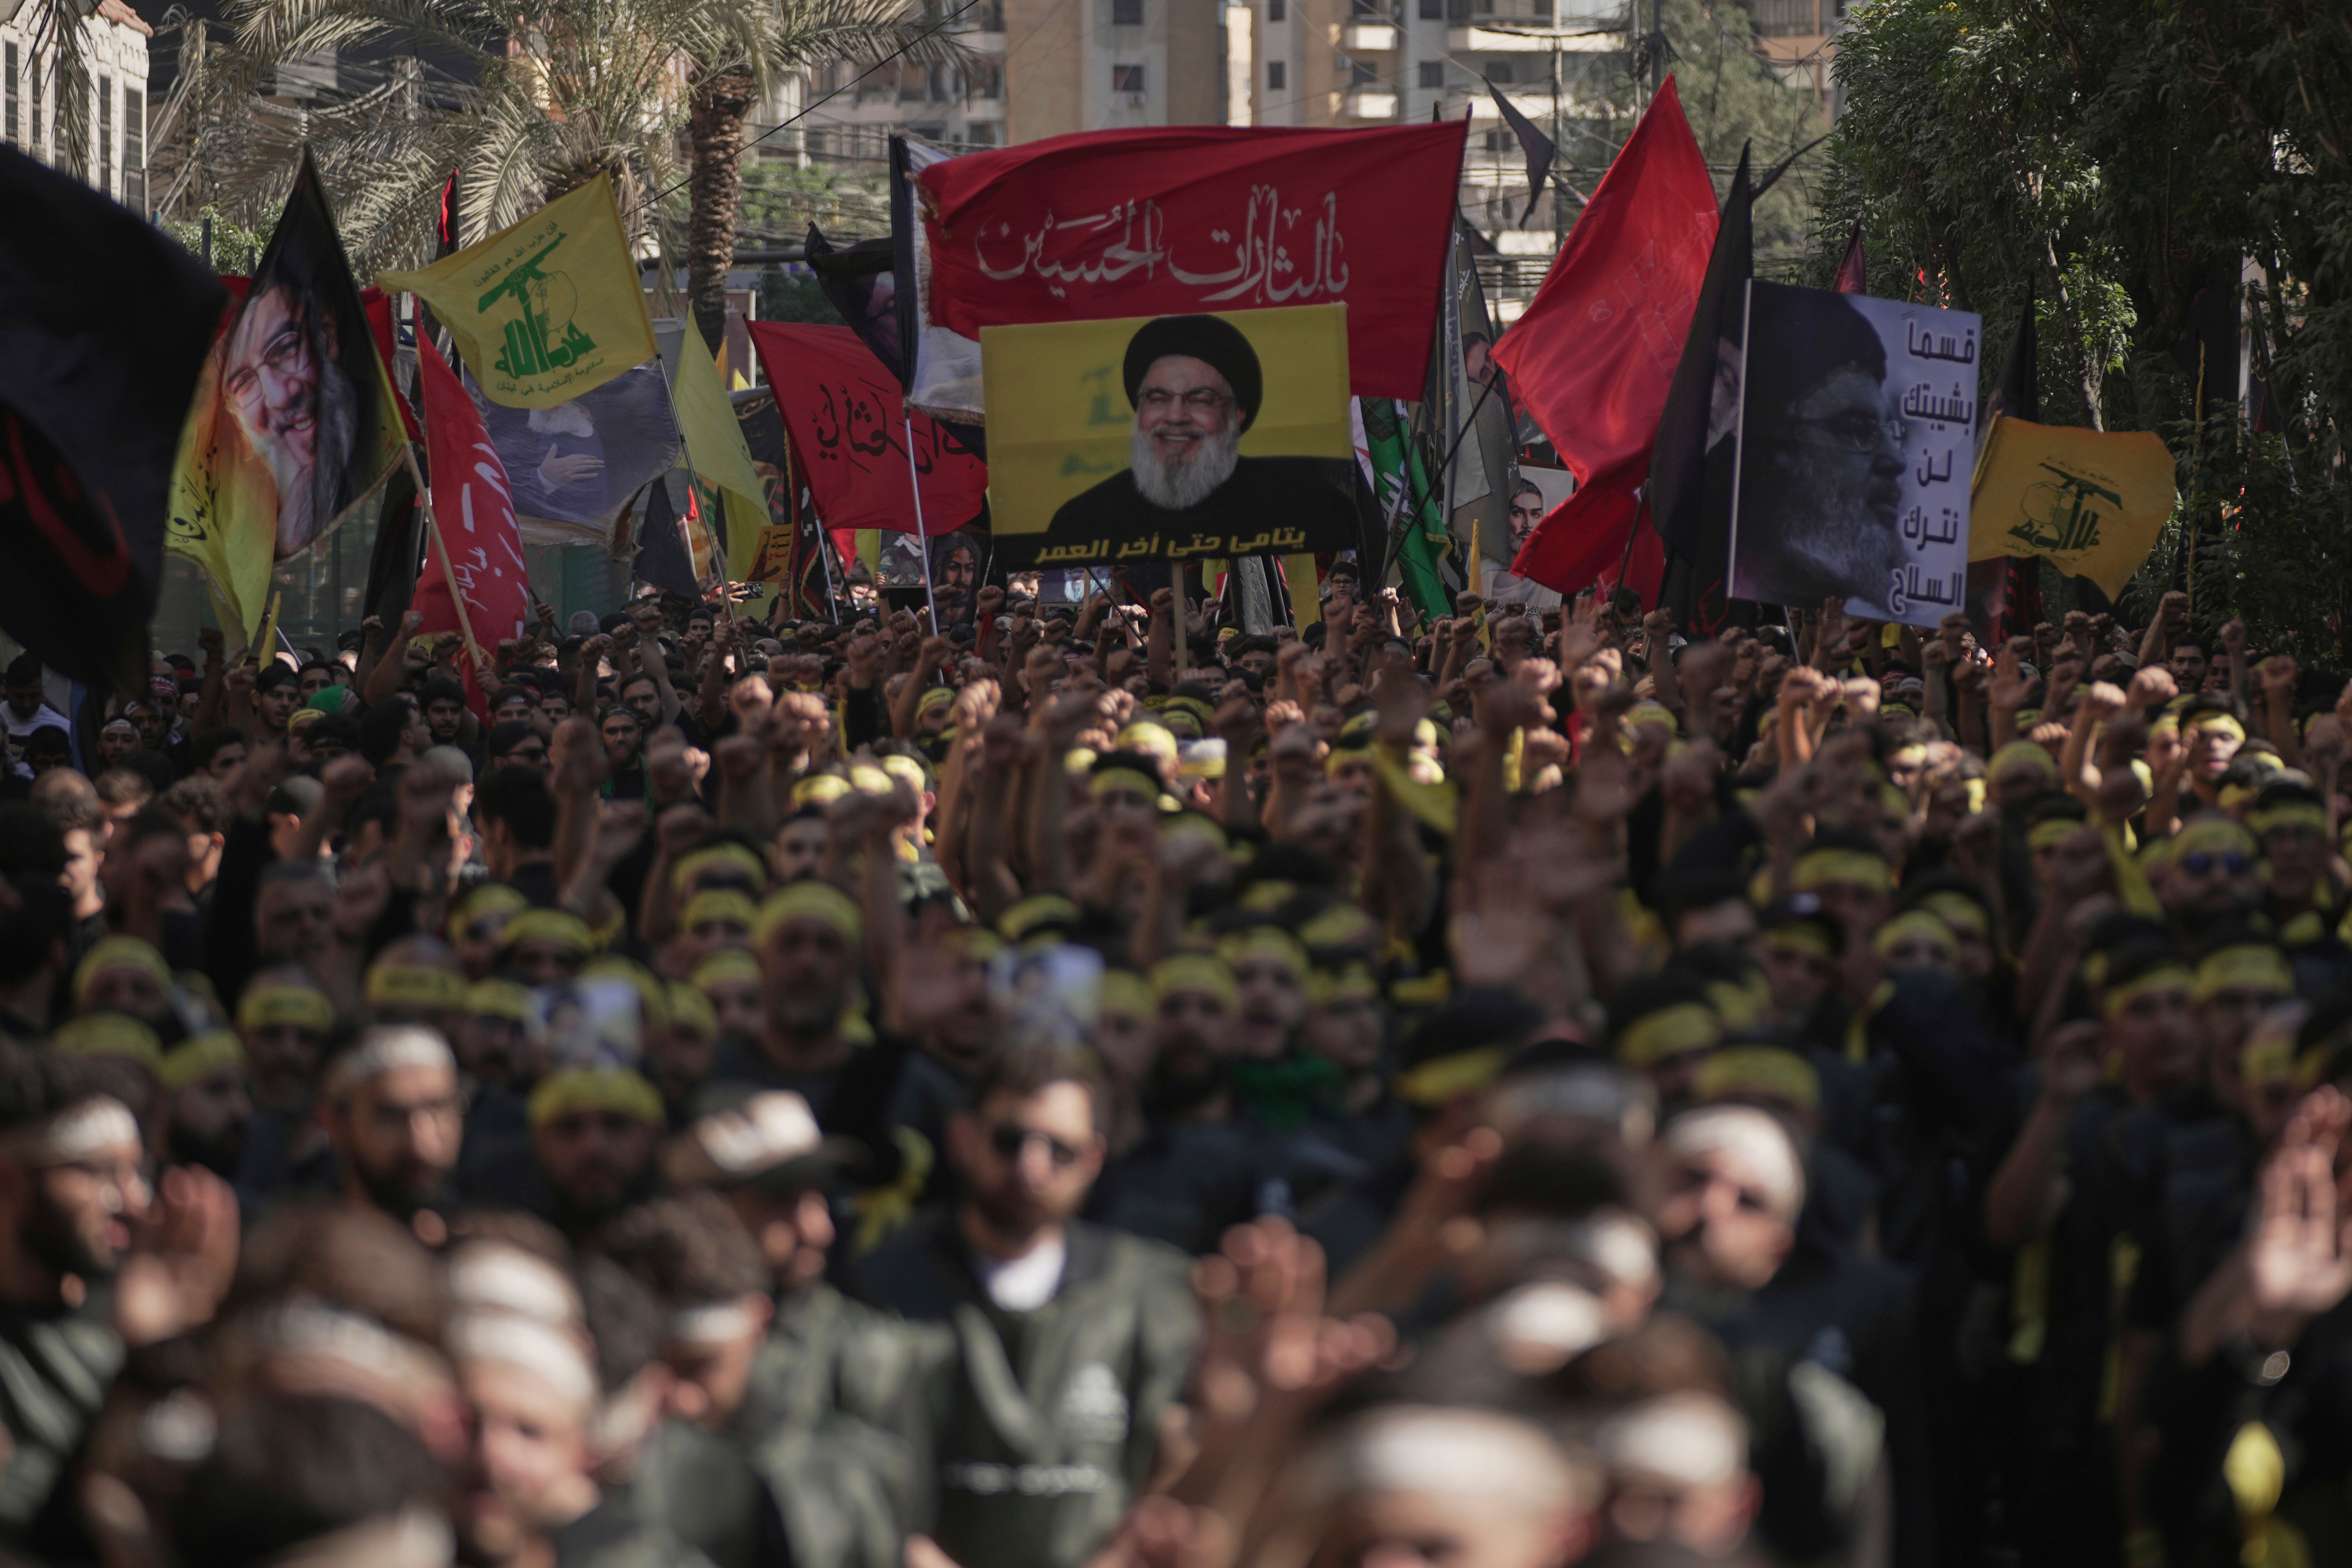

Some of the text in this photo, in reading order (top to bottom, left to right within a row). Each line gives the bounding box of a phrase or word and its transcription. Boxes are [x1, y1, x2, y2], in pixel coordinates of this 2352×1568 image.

[513, 246, 526, 258] الله
[527, 234, 545, 249] حزب
[1909, 321, 1975, 365] قسما
[521, 384, 535, 395] في
[1904, 381, 1973, 437] بشيبتك
[1917, 447, 1953, 487] لن
[1230, 527, 1306, 553] يتامى
[1904, 506, 1959, 551] نترك
[1034, 539, 1110, 564] العمر
[1167, 533, 1221, 558] حتى
[1891, 565, 1963, 613] السلاح
